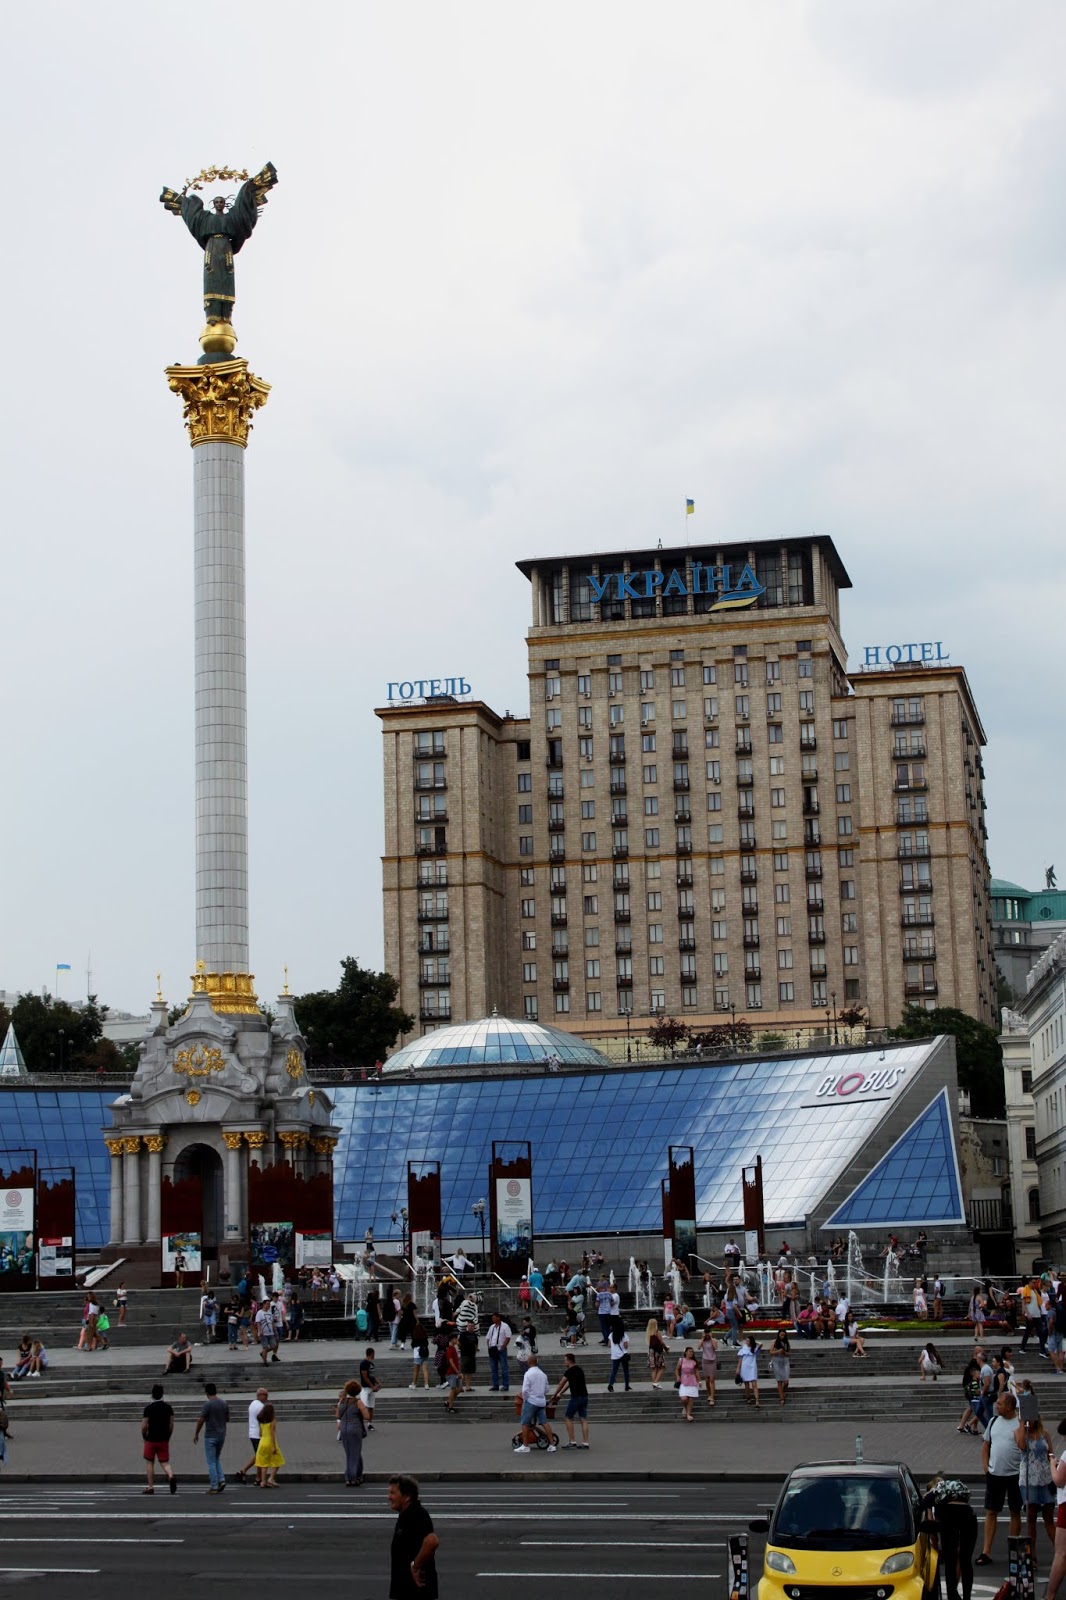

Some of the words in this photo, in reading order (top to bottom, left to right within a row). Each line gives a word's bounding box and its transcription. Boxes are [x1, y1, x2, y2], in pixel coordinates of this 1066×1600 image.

[587, 561, 762, 603] УКРАЇНА
[863, 641, 950, 665] HOTEL
[386, 677, 472, 700] ГОТЕЛЬ
[814, 1066, 906, 1097] GLOBUS
